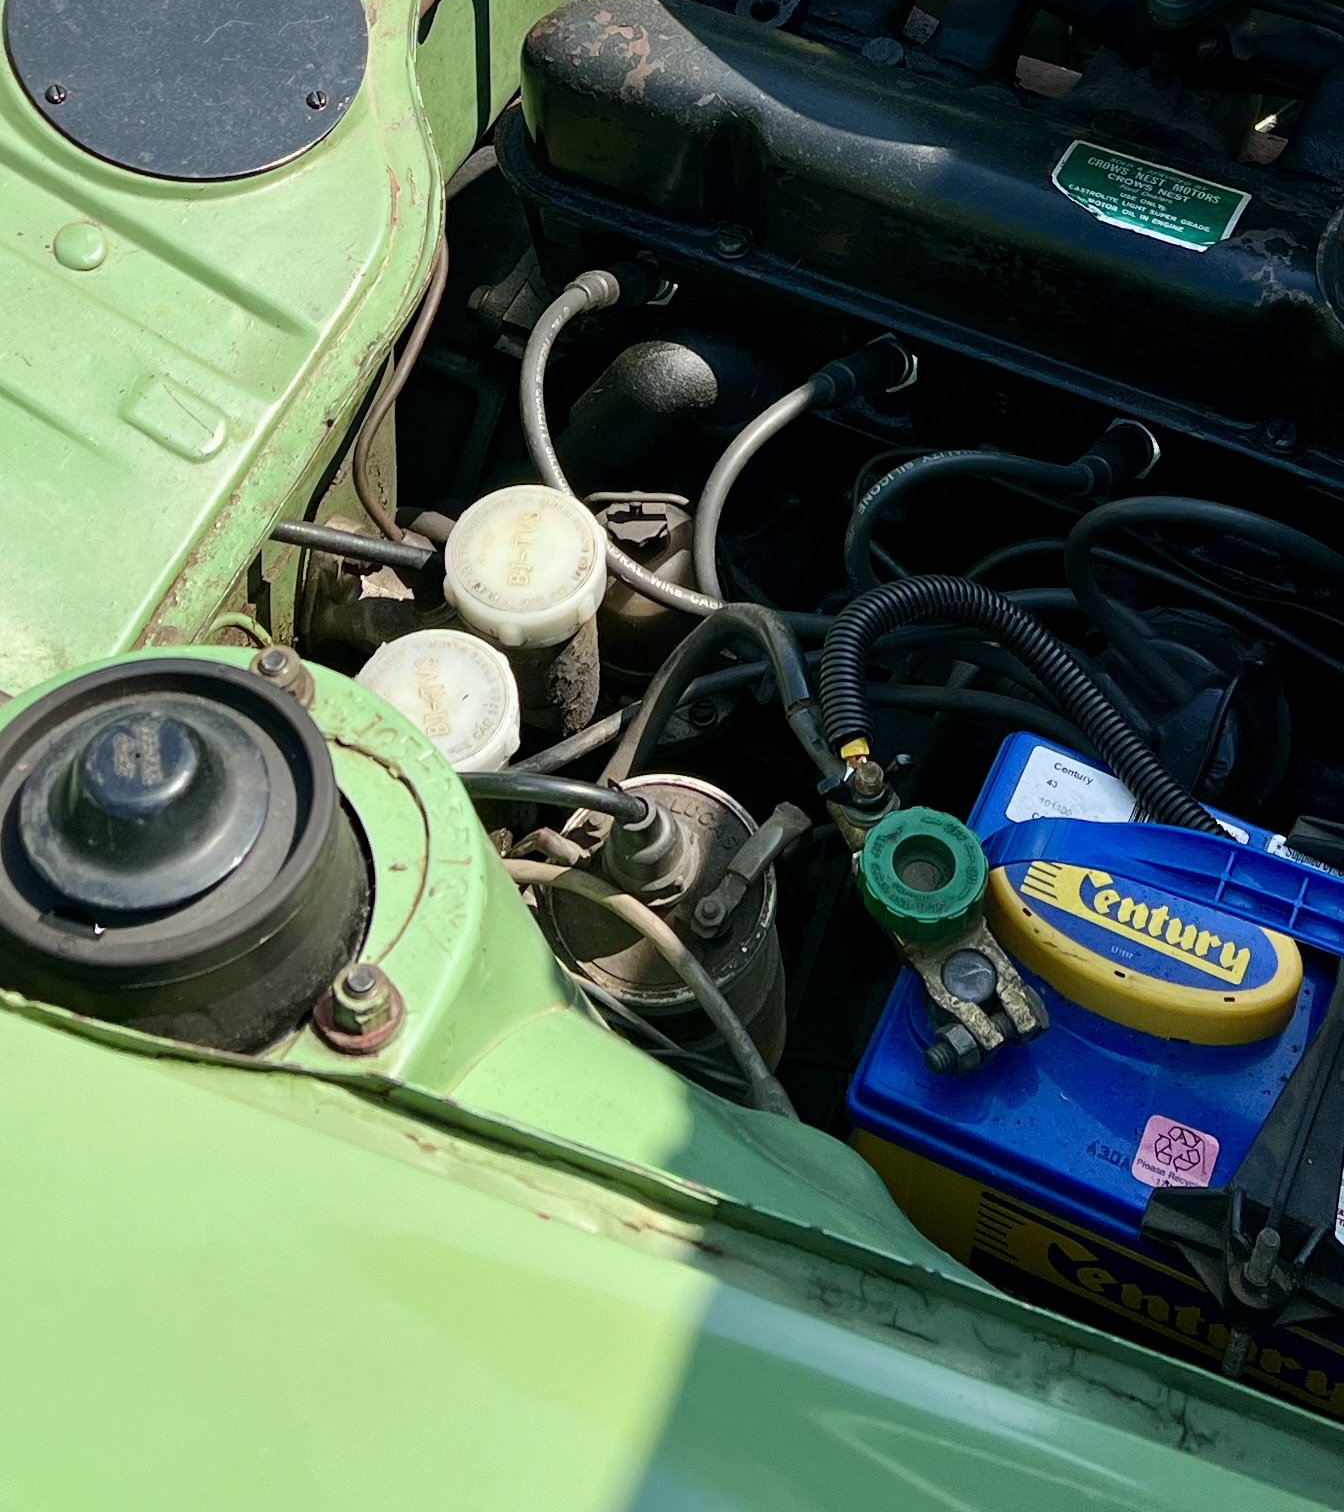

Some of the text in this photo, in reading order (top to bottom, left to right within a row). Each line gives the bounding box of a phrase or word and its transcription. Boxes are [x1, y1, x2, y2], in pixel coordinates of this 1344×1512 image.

[1087, 156, 1221, 204] CROWS NEST MOTORS
[1107, 172, 1192, 203] CROWS NEST
[1120, 192, 1138, 202] USE
[1068, 183, 1211, 233] CASTROLITE LIGHT SUPER GRADE
[1088, 197, 1185, 233] MOTOR OIL IN ENGINE
[857, 461, 914, 515] SILICONE
[650, 575, 683, 598] WIRE
[1053, 762, 1095, 785] Century
[669, 798, 739, 851] LUCAS
[1036, 861, 1251, 982] Century
[1136, 1158, 1167, 1177] Please
